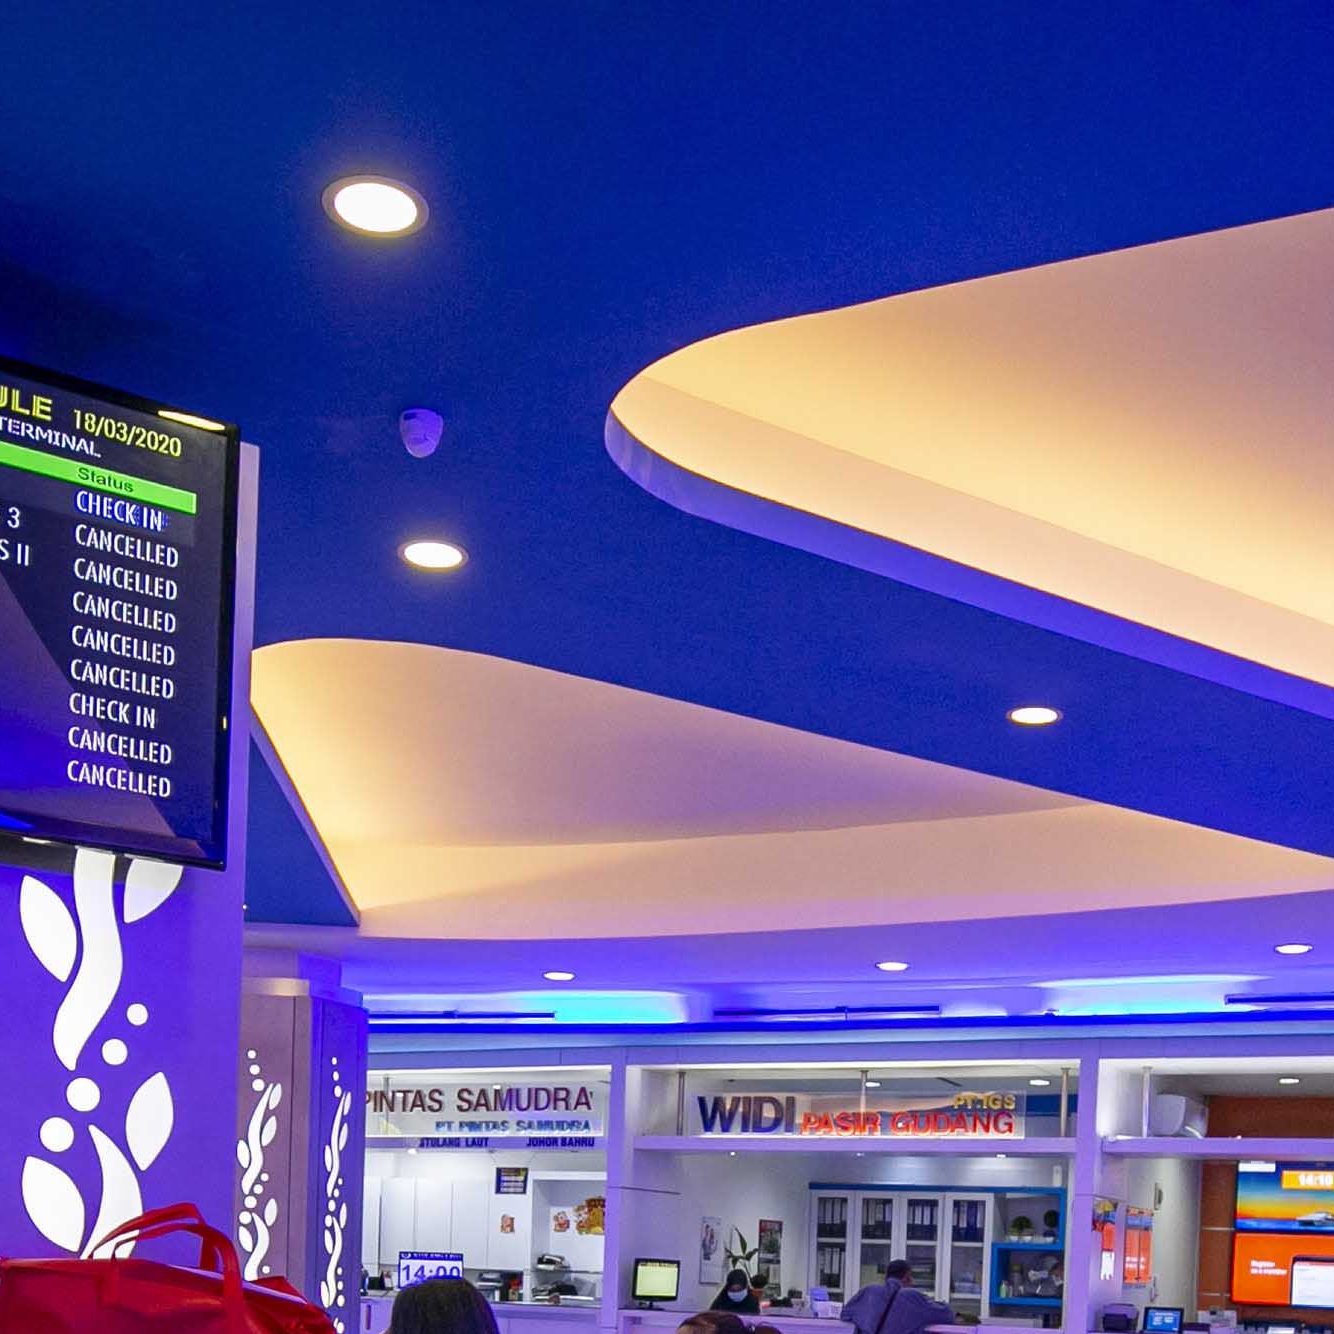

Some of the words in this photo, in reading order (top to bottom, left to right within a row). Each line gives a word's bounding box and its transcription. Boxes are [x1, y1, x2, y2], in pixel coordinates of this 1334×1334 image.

[73, 409, 182, 457] 18/03/2020
[77, 467, 135, 494] Status
[76, 490, 138, 525] CHECK
[142, 505, 163, 532] IN
[7, 506, 21, 529] 3
[75, 525, 178, 568] CANCELLED
[17, 542, 31, 567] II
[74, 557, 177, 601] CANCELLED
[73, 591, 176, 635] CANCELLED
[72, 624, 176, 667] CANCELLED
[71, 659, 175, 700] CANCELLED
[69, 693, 131, 725] CHECK
[136, 705, 157, 730] IN
[68, 726, 172, 766] CANCELLED
[67, 760, 171, 798] CANCELLED
[456, 1087, 592, 1113] SAMUDRA
[697, 1095, 798, 1134] WIDI
[458, 1120, 509, 1132] PINTAS
[516, 1119, 592, 1132] SAMUDRA
[465, 1136, 489, 1147] LAUT
[526, 1136, 559, 1147] JOHOR
[561, 1136, 595, 1147] BAHRU
[800, 1111, 880, 1136] PASIR
[890, 1109, 1016, 1136] GUDANG
